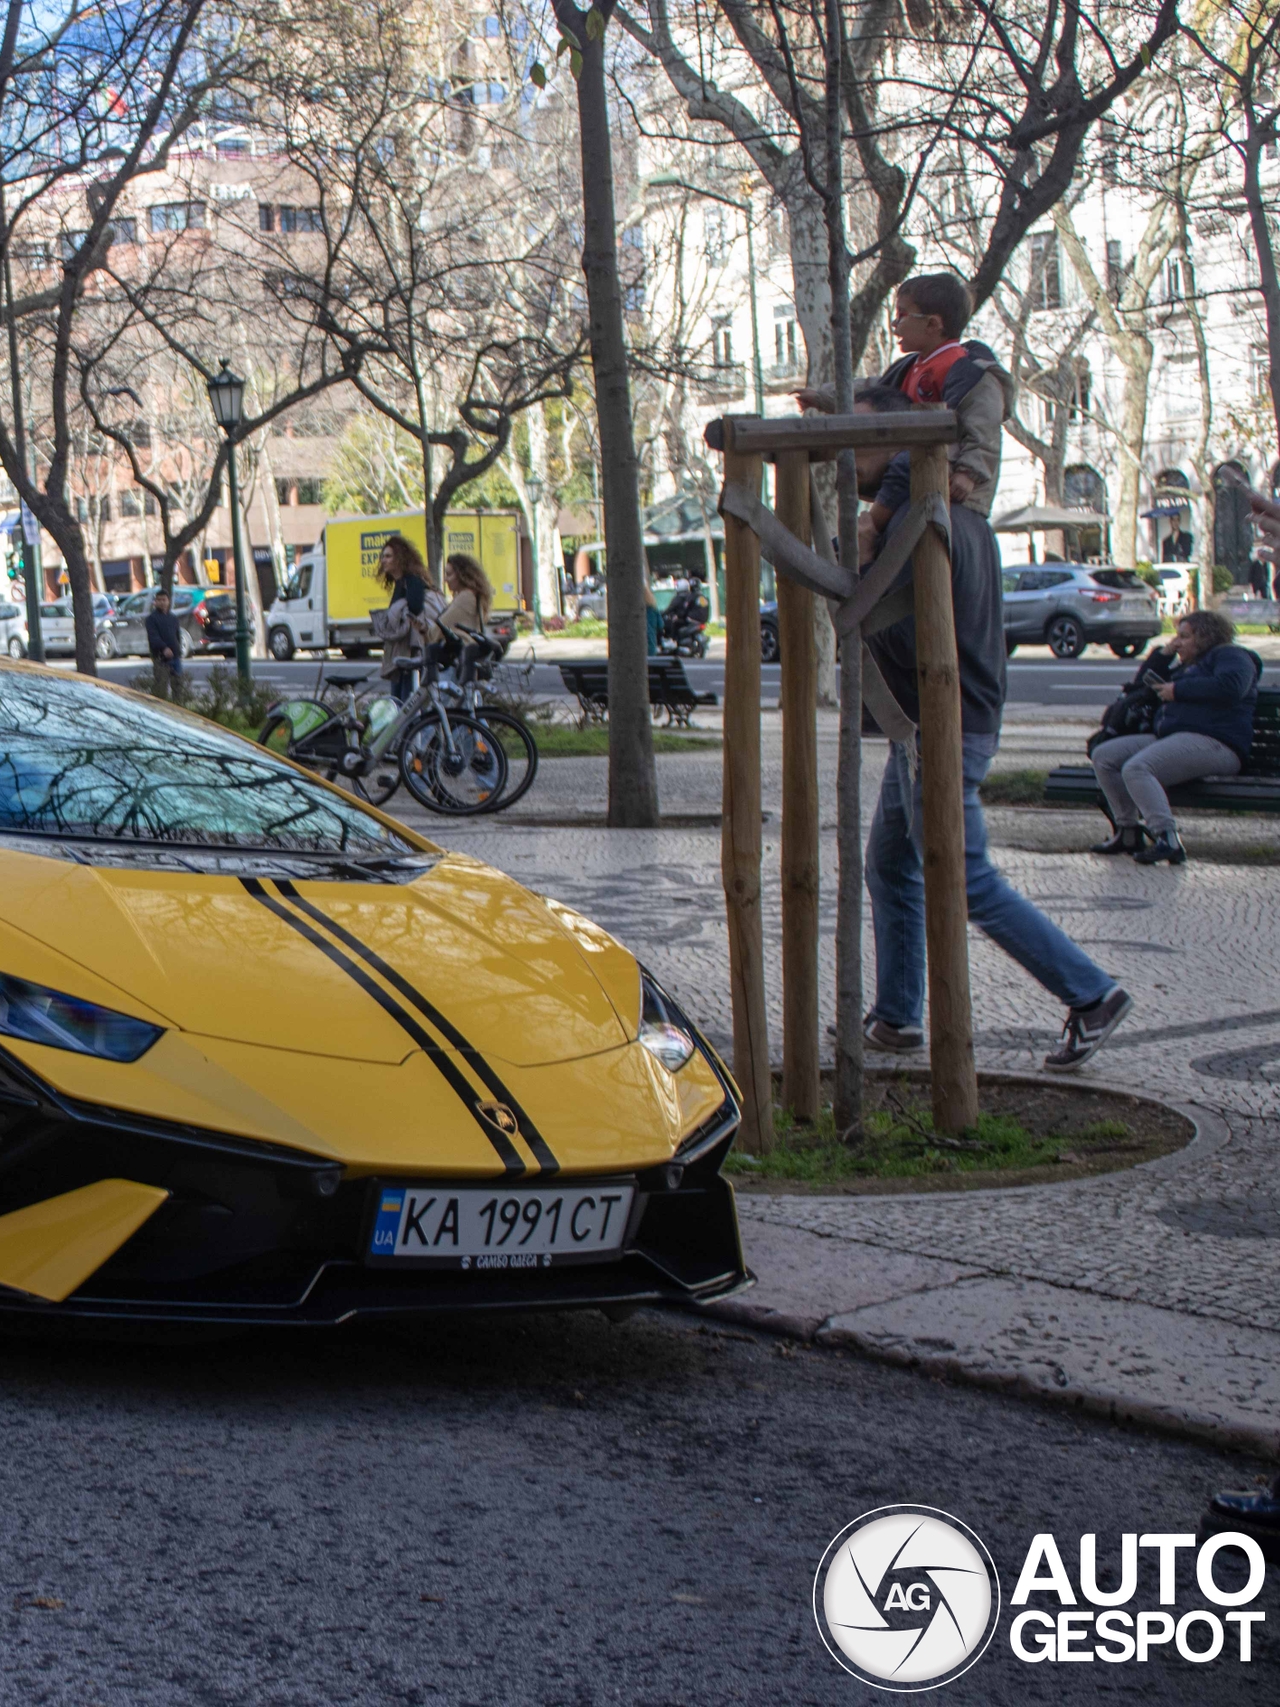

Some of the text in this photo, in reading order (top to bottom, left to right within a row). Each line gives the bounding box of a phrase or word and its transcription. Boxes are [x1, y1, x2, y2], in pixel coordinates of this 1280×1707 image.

[254, 550, 270, 559] BBV
[362, 553, 379, 565] EXP
[402, 1195, 622, 1246] KA 1991 CT
[374, 1230, 394, 1246] UA
